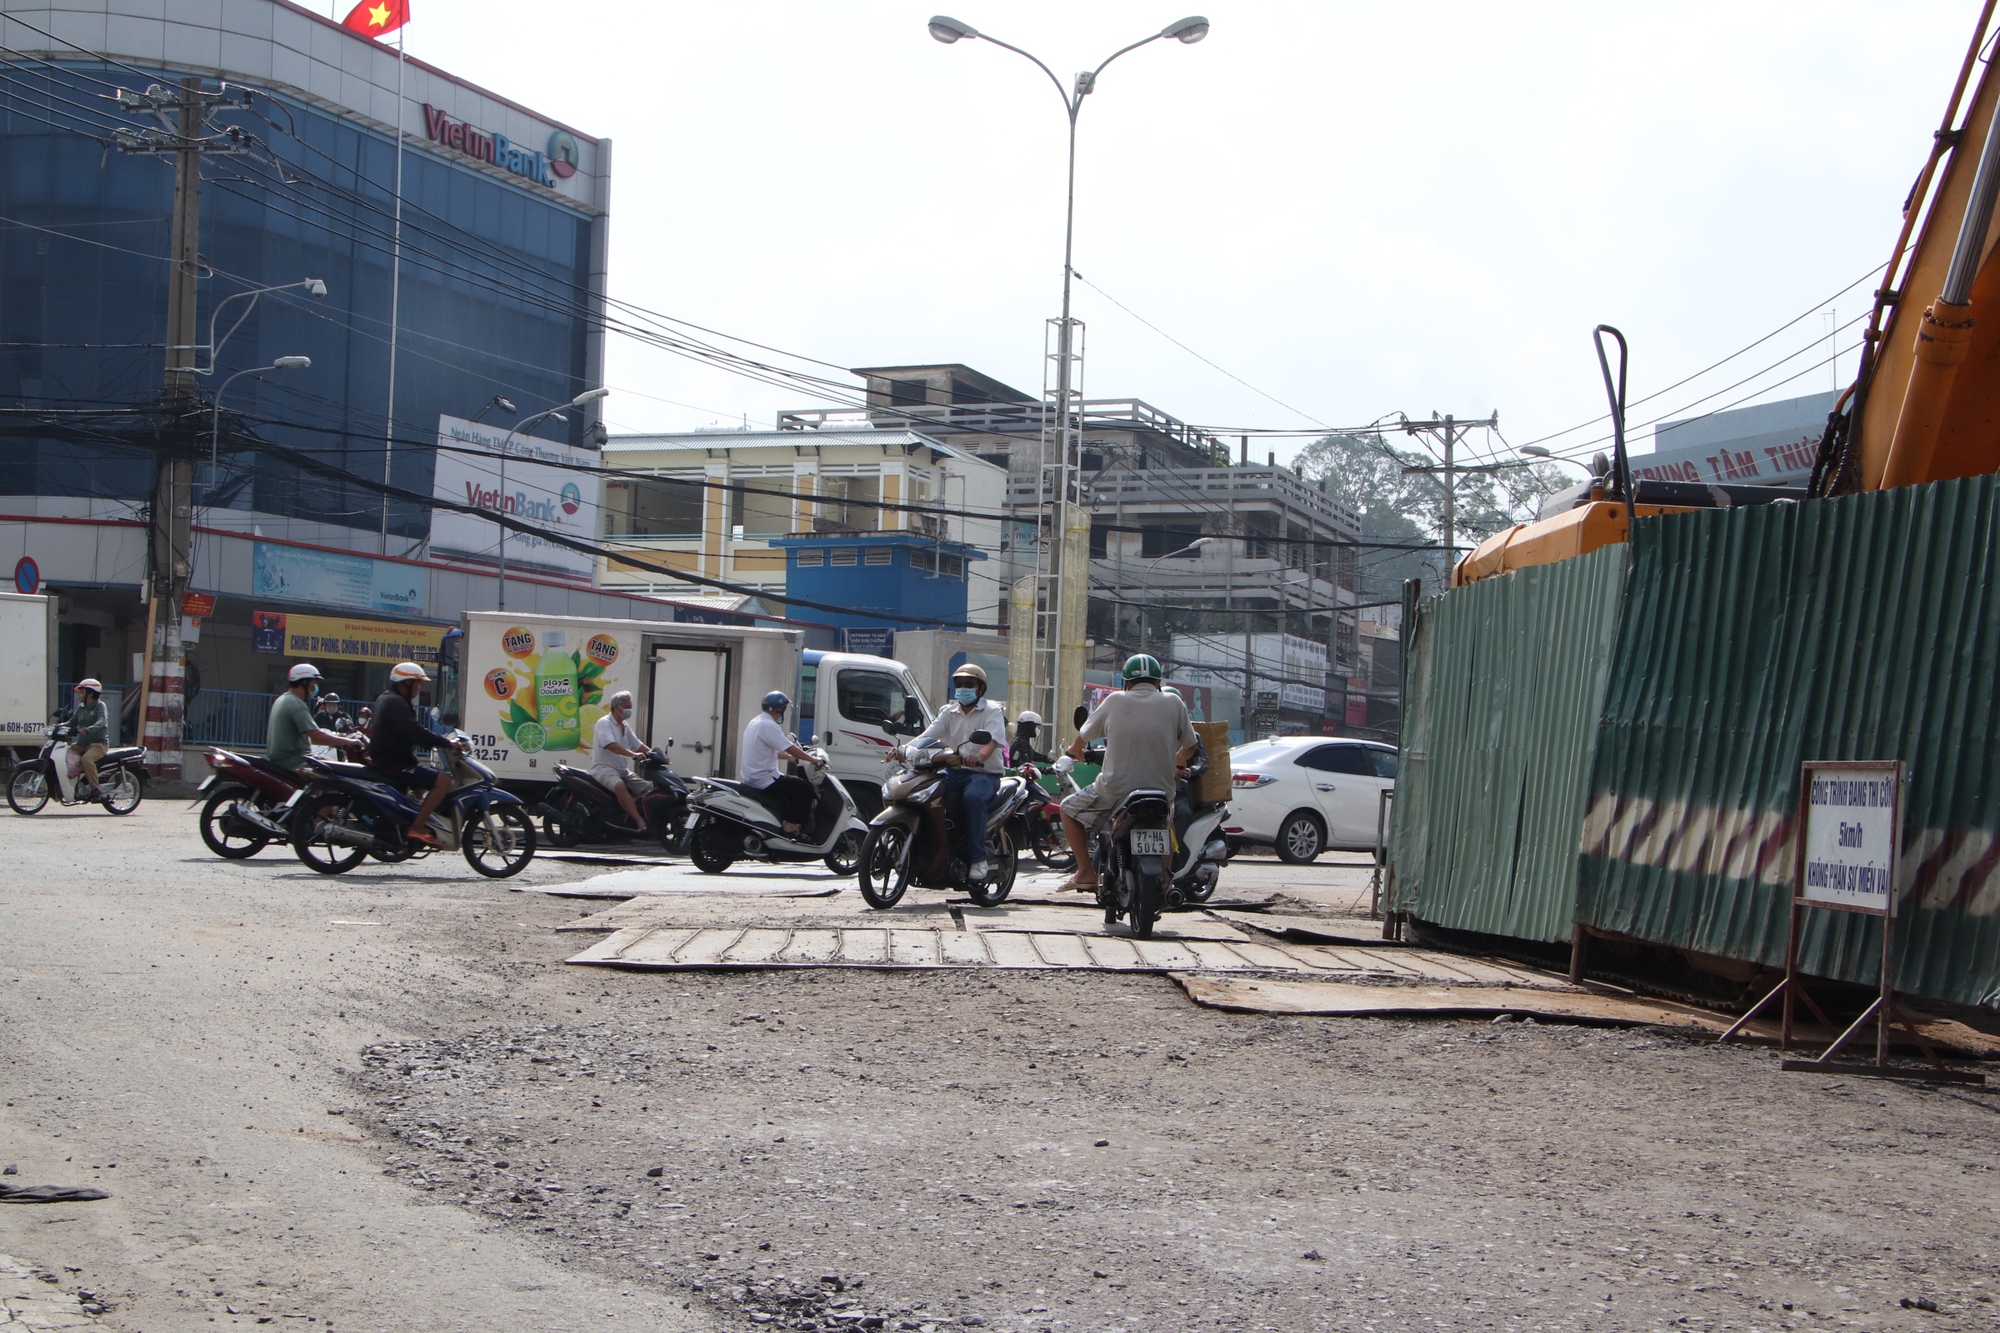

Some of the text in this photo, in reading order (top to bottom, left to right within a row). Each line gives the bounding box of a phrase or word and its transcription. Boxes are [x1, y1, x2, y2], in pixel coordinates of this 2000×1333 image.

[423, 103, 552, 187] VietinBank
[493, 437, 513, 452] TMP
[1706, 448, 1760, 481] TÂM
[466, 481, 557, 522] VietnBank
[291, 635, 309, 651] CHUNG
[311, 636, 320, 652] TAY
[342, 634, 359, 655] CHỐNG
[360, 640, 369, 656] MA
[505, 633, 532, 648] TĂNG
[591, 638, 616, 657] TĂNG
[494, 678, 508, 696] C
[472, 735, 496, 746] 51D
[468, 749, 509, 761] 32.57
[1829, 776, 1848, 806] TRÌNH
[1848, 780, 1867, 807] ĐANG
[1868, 782, 1879, 807] THI
[1136, 831, 1164, 842] 77-H4
[1838, 822, 1862, 849] 5km/h
[1137, 843, 1165, 853] 5043
[1808, 857, 1829, 888] KHÔNG
[1829, 860, 1847, 895] PHẬN
